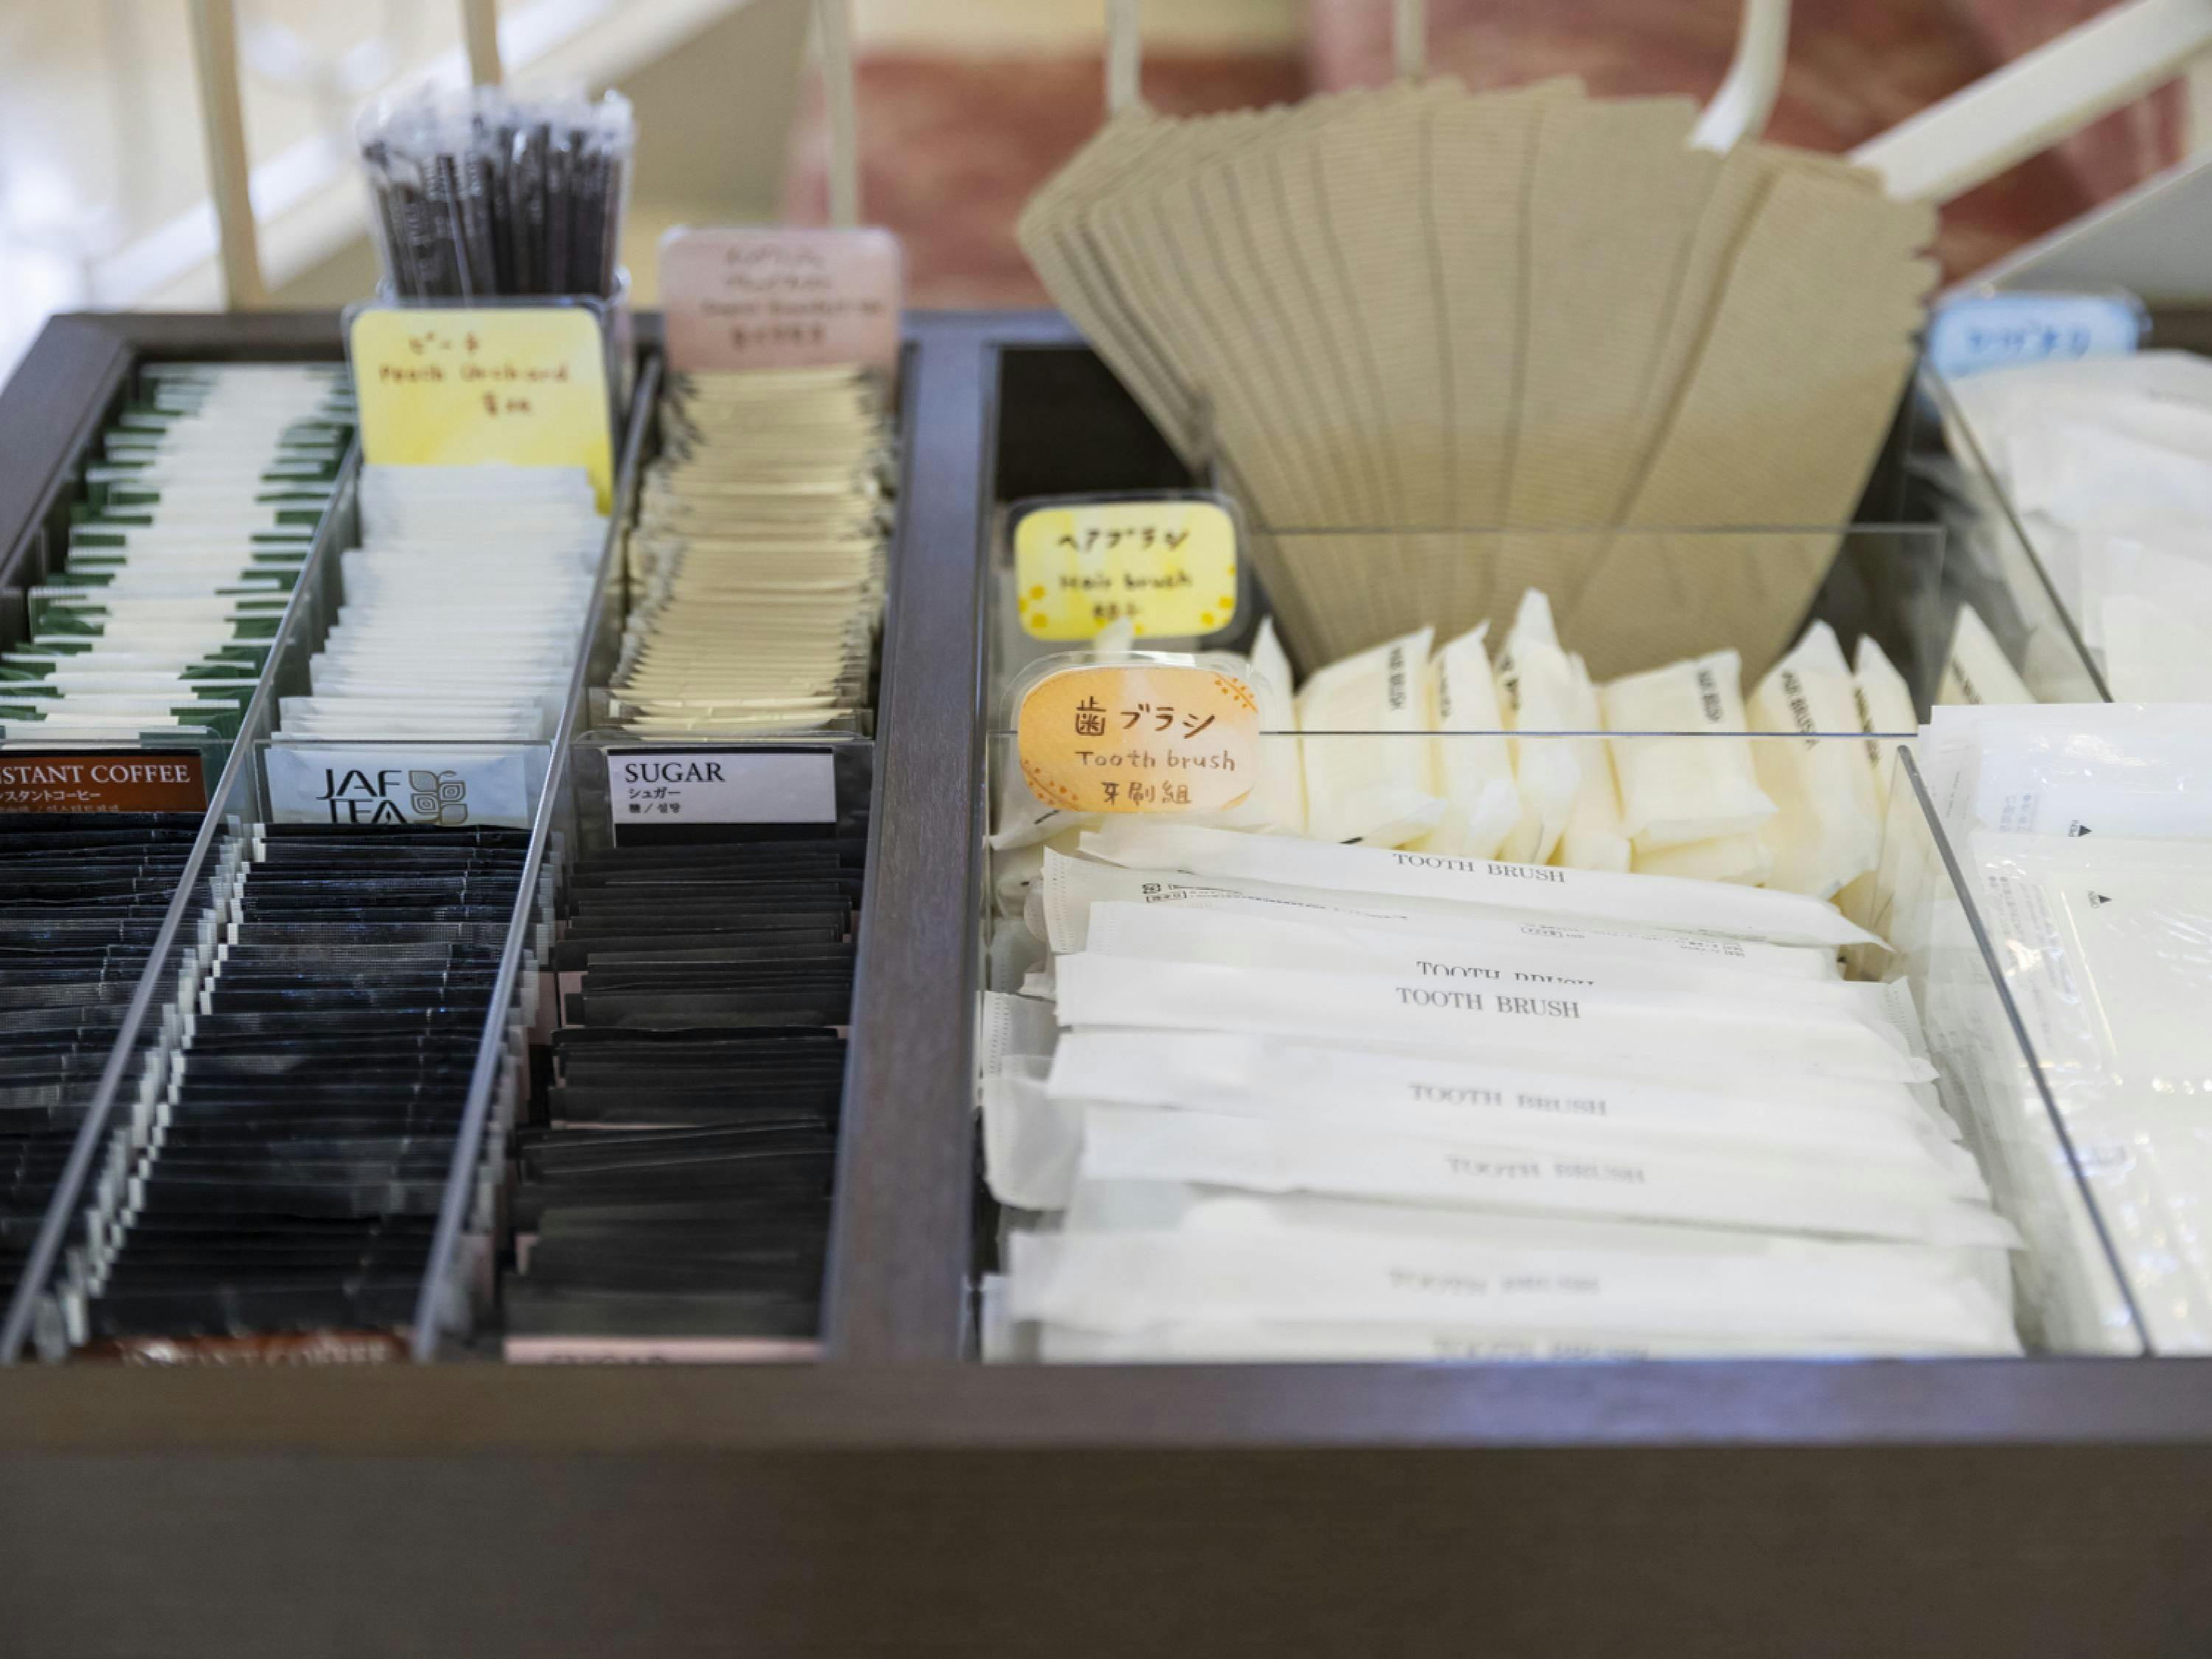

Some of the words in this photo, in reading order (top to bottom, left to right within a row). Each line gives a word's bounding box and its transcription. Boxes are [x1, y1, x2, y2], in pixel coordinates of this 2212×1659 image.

[1075, 696, 1216, 739] 歯ブラシ
[0, 765, 85, 785] STANT
[90, 765, 191, 784] COFFEE
[625, 762, 726, 783] SUGAR
[1076, 751, 1156, 768] Tooth
[1168, 750, 1236, 772] brush
[316, 768, 403, 800] JAF
[628, 786, 681, 799] シュガー
[1393, 852, 1475, 873] TOOTH
[1486, 863, 1567, 884] BRUSH
[1395, 987, 1484, 1011] TOOTH
[1495, 995, 1581, 1020] BRUSH
[1409, 1082, 1503, 1107] TOOTH
[1516, 1093, 1607, 1116] BRUSH
